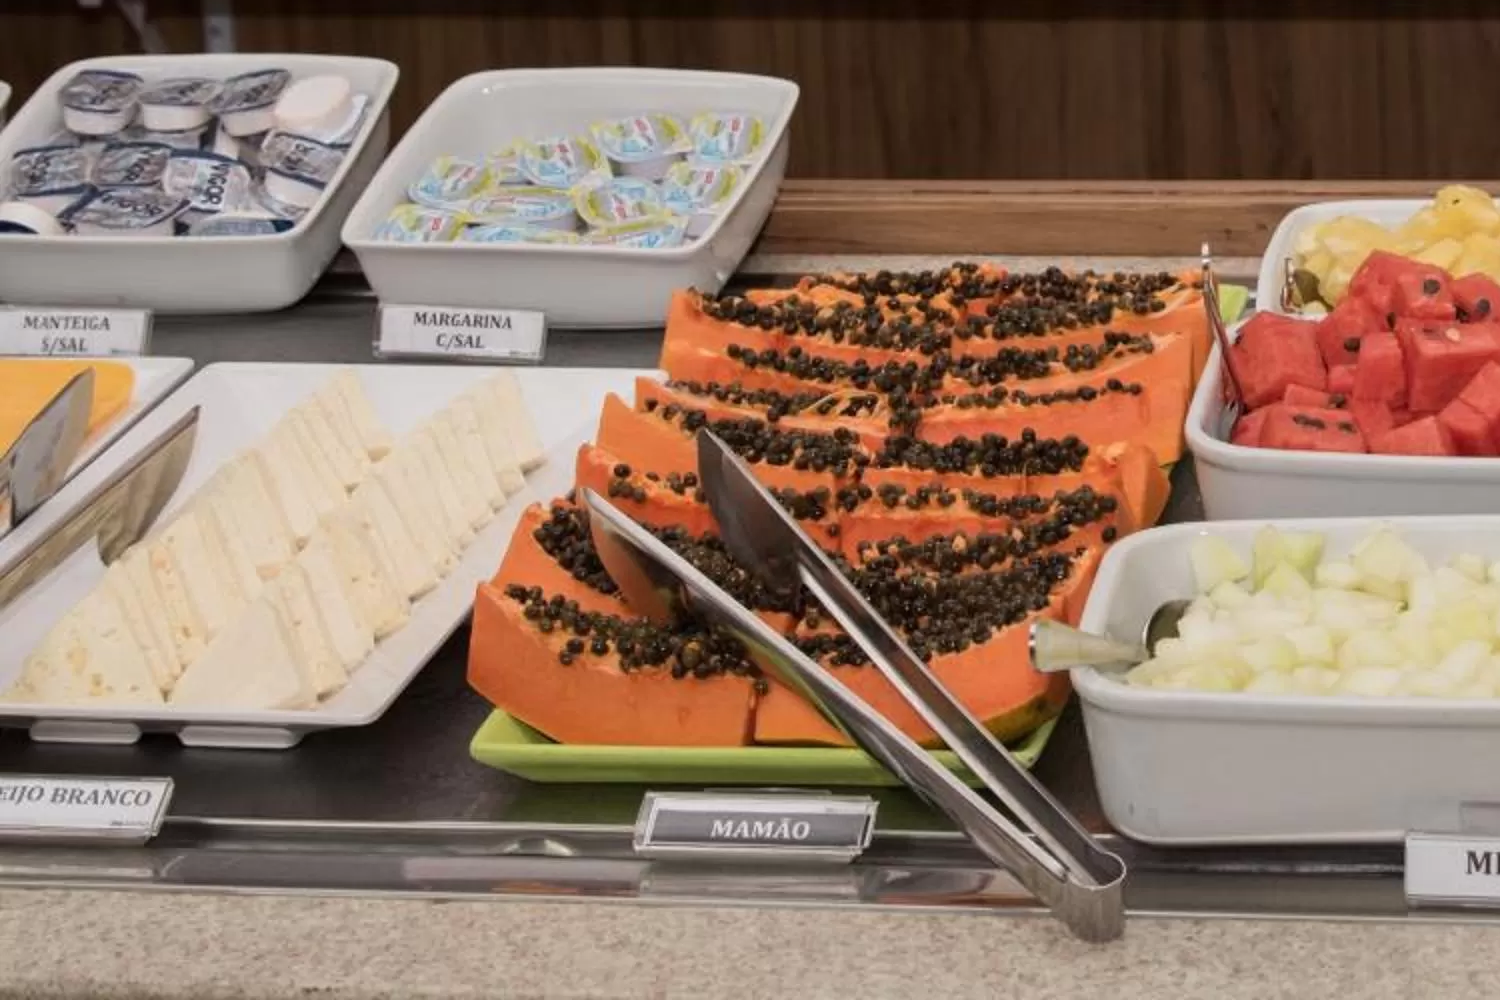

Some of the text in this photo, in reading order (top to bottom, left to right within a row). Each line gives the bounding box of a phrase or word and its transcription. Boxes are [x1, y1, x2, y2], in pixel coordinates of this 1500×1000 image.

[23, 315, 111, 331] MANTEIGA
[413, 311, 513, 330] MARGARINA
[40, 337, 88, 356] S/SAL
[435, 332, 486, 351] C/SAL
[51, 787, 152, 807] BRANCO
[710, 817, 811, 840] MAMÃO
